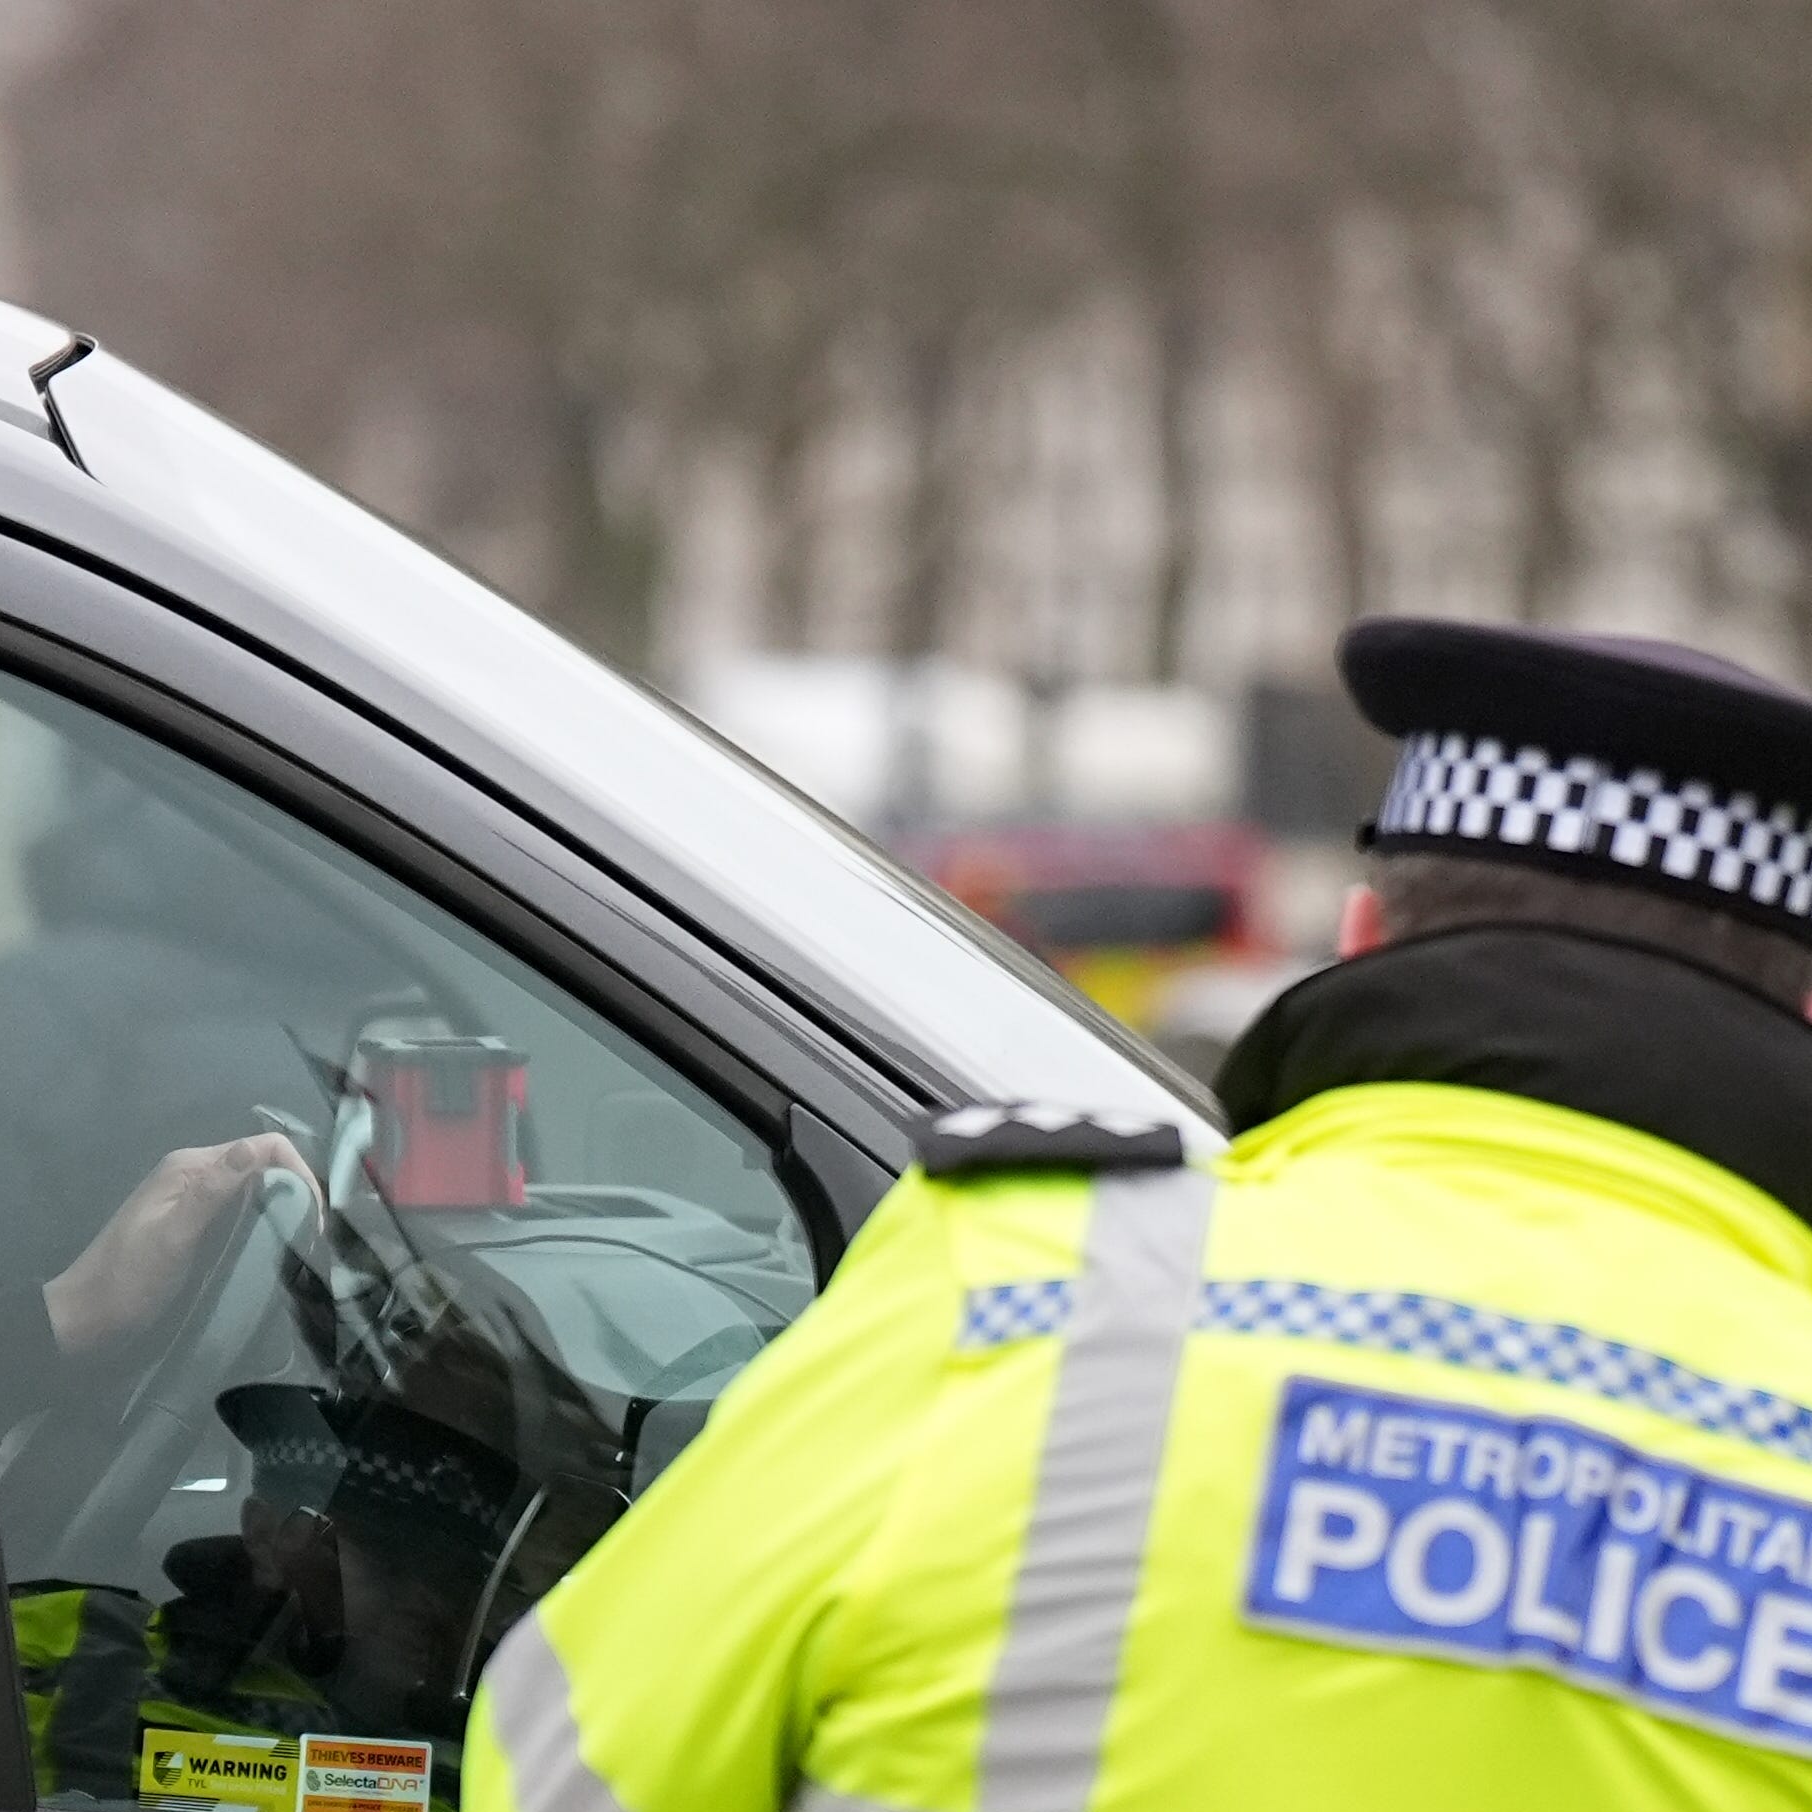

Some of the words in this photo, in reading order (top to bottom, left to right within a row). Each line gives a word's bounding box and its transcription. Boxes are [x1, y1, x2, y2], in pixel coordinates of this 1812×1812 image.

[188, 1757, 287, 1782] WARNING
[311, 1749, 365, 1765] THIEVES
[367, 1753, 422, 1768] BEWARE
